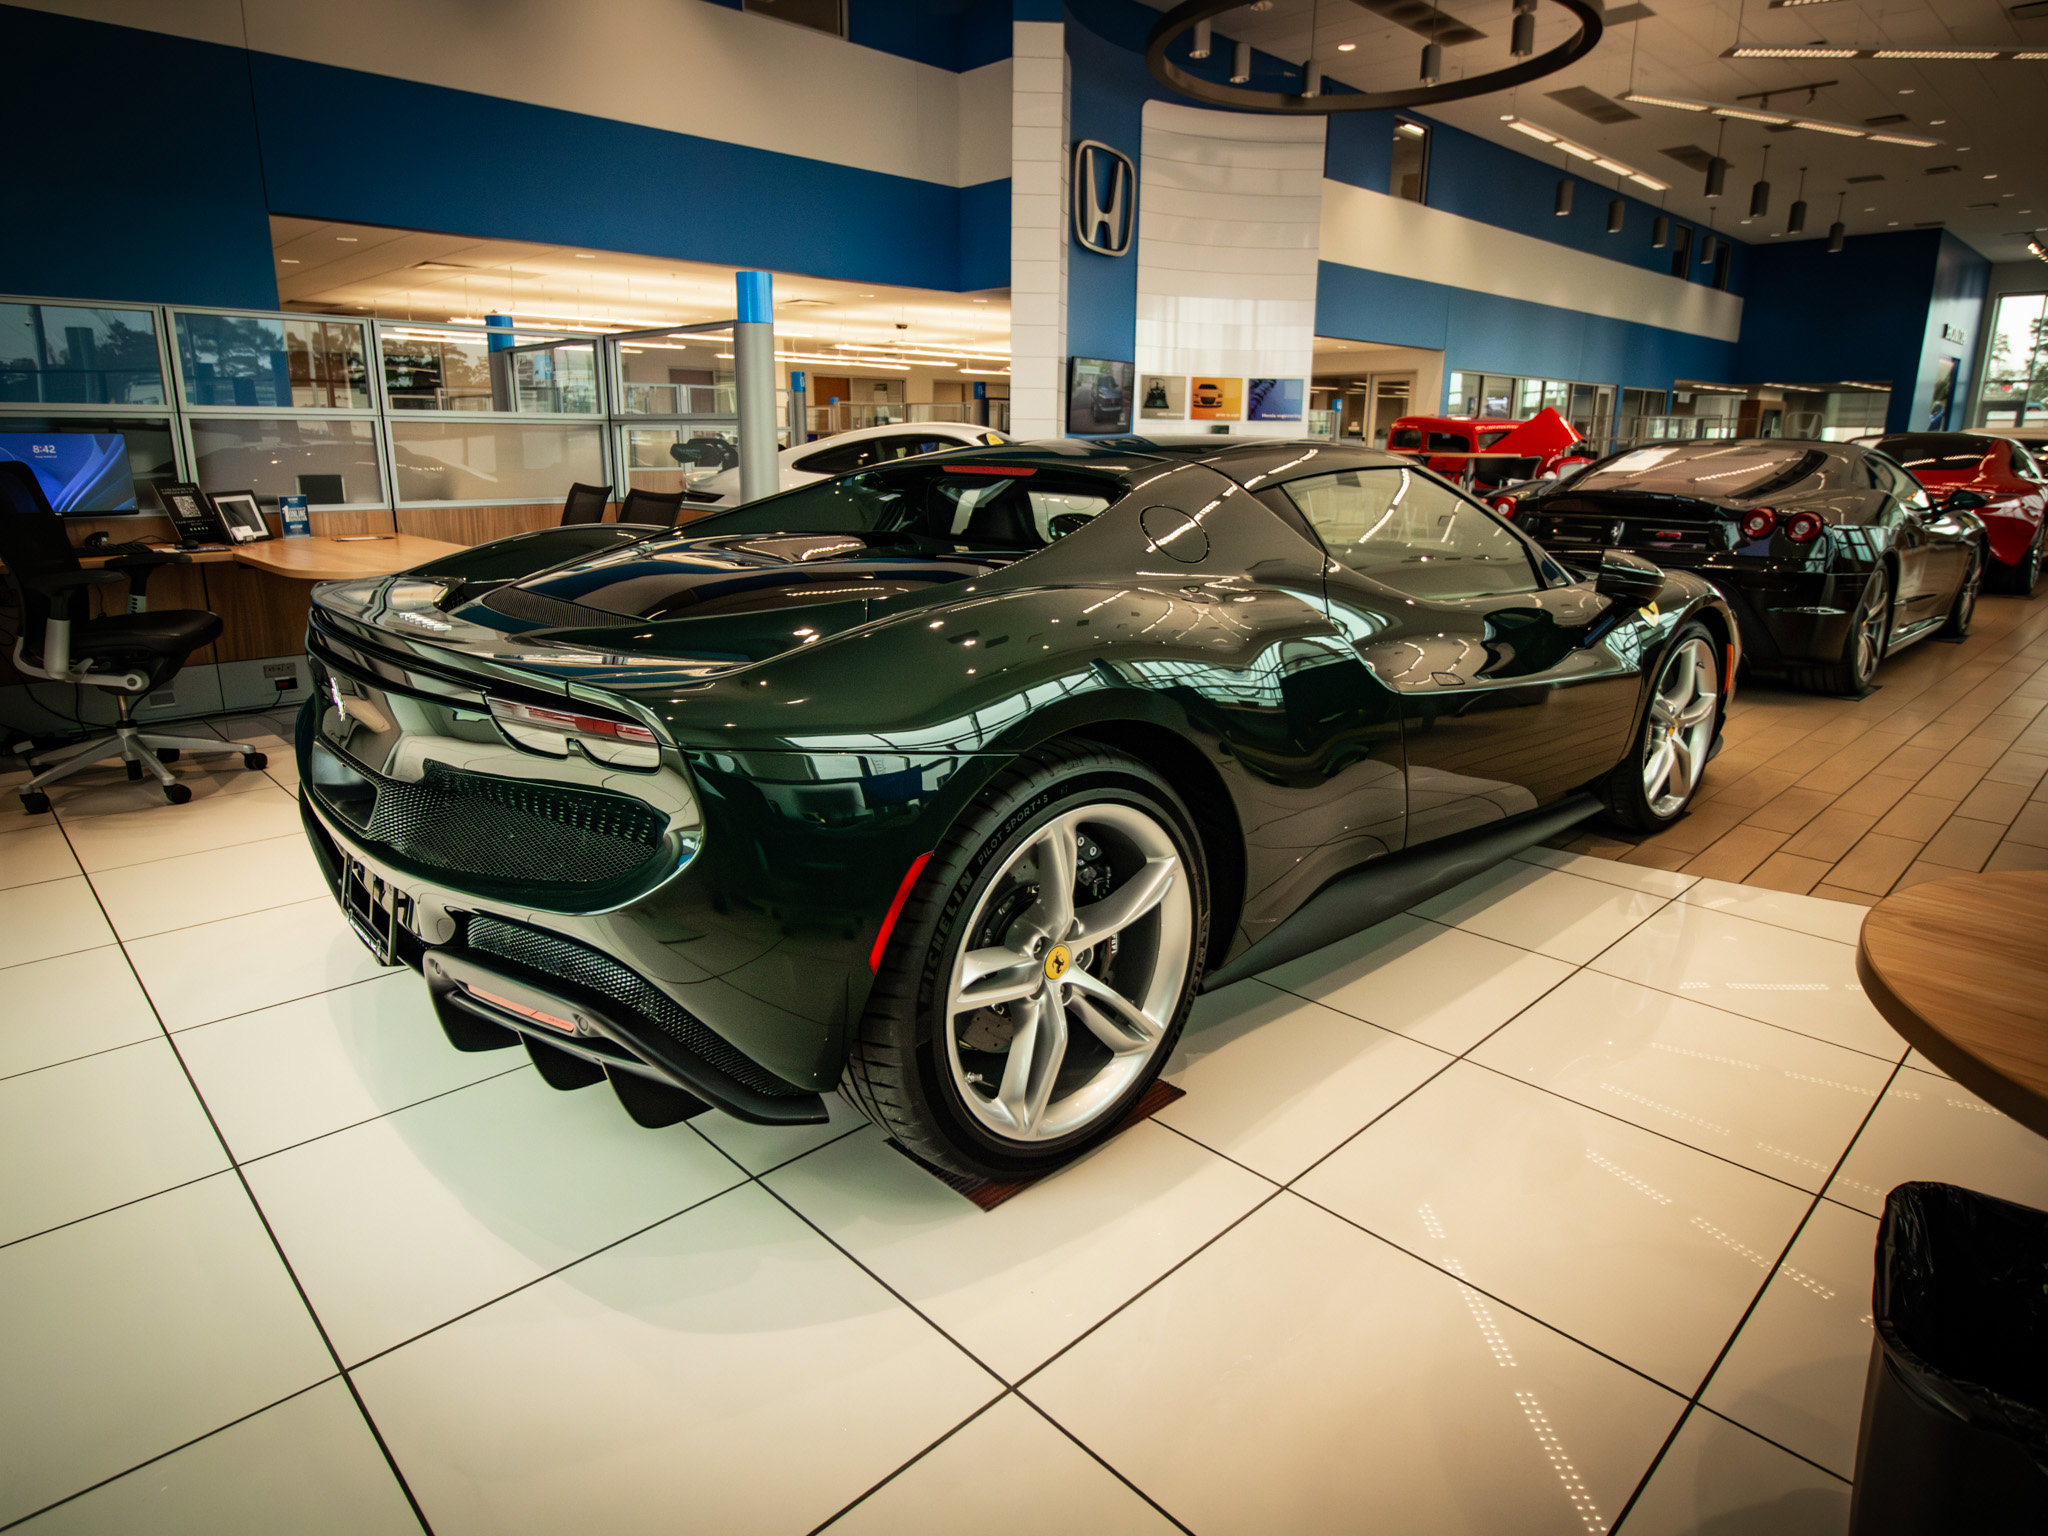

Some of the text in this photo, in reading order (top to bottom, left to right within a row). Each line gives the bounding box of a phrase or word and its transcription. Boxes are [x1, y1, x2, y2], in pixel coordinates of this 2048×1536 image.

[32, 445, 56, 453] 8:42
[919, 871, 974, 1004] MICHELIN
[978, 831, 1003, 865] PILOT
